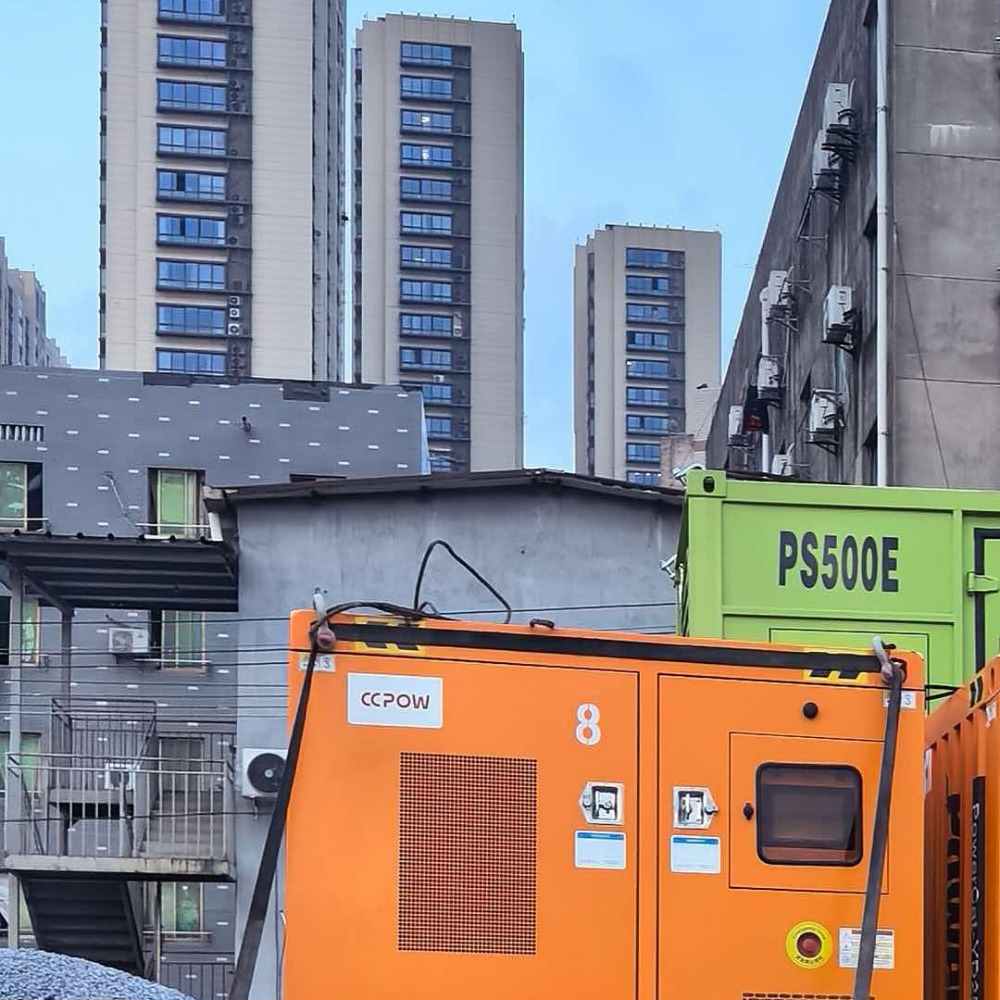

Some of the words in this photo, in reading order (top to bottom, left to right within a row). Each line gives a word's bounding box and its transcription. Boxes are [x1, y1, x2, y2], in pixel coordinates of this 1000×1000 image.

[778, 530, 899, 593] PS500E
[361, 692, 430, 710] CCPOW
[576, 703, 602, 746] 8
